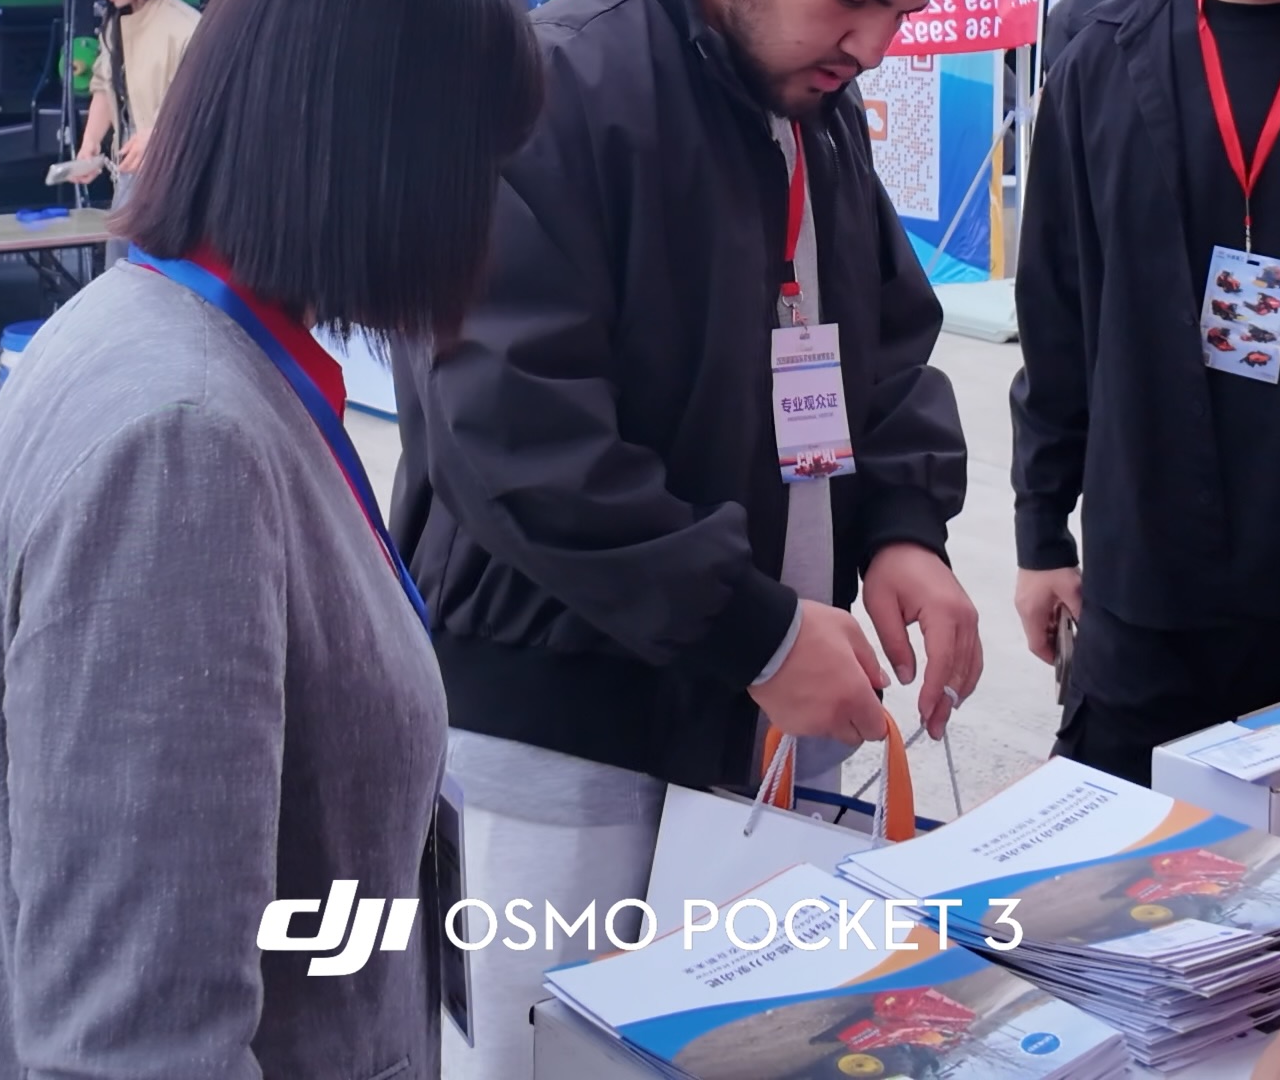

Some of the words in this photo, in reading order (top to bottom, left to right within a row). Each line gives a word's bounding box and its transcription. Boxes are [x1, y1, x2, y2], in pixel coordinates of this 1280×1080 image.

[781, 392, 838, 414] 专业观众证
